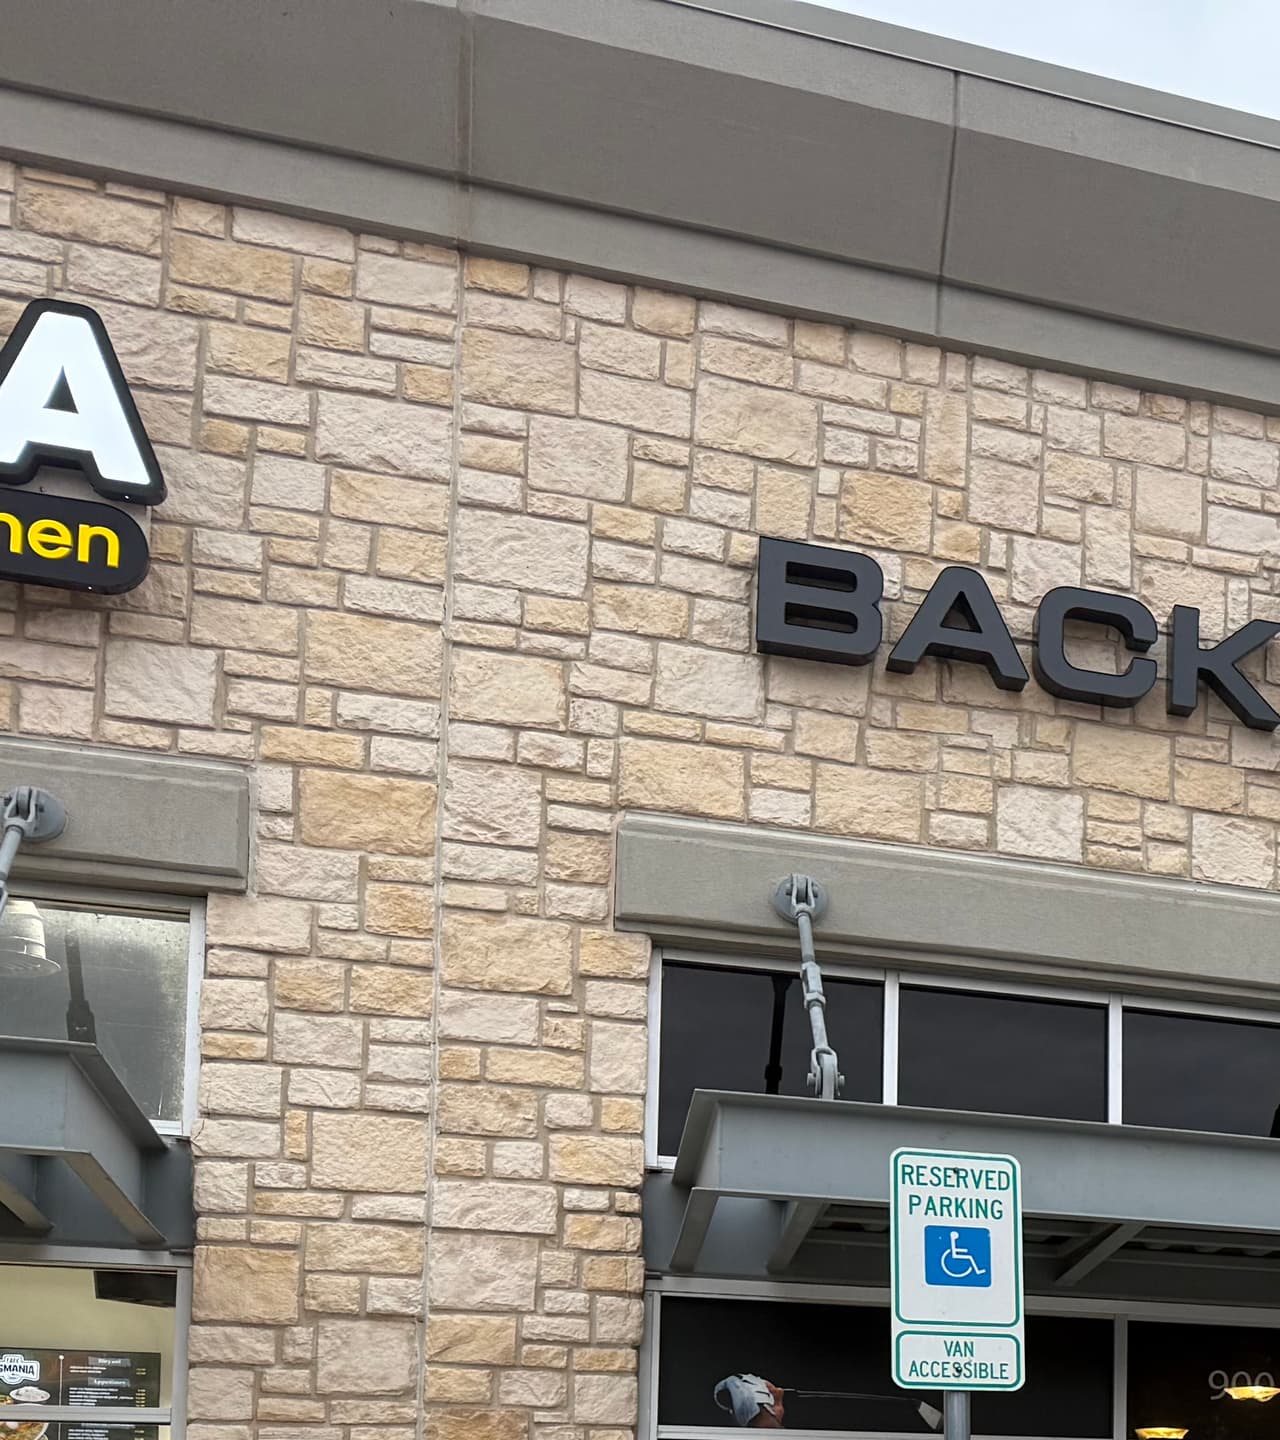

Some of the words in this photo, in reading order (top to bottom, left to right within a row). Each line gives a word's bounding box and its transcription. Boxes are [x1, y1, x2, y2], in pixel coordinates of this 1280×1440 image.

[901, 1164, 1010, 1191] RESERVED
[908, 1195, 1004, 1220] PARKING
[943, 1340, 975, 1358] VAN
[908, 1360, 1009, 1380] ACCESSIBLE
